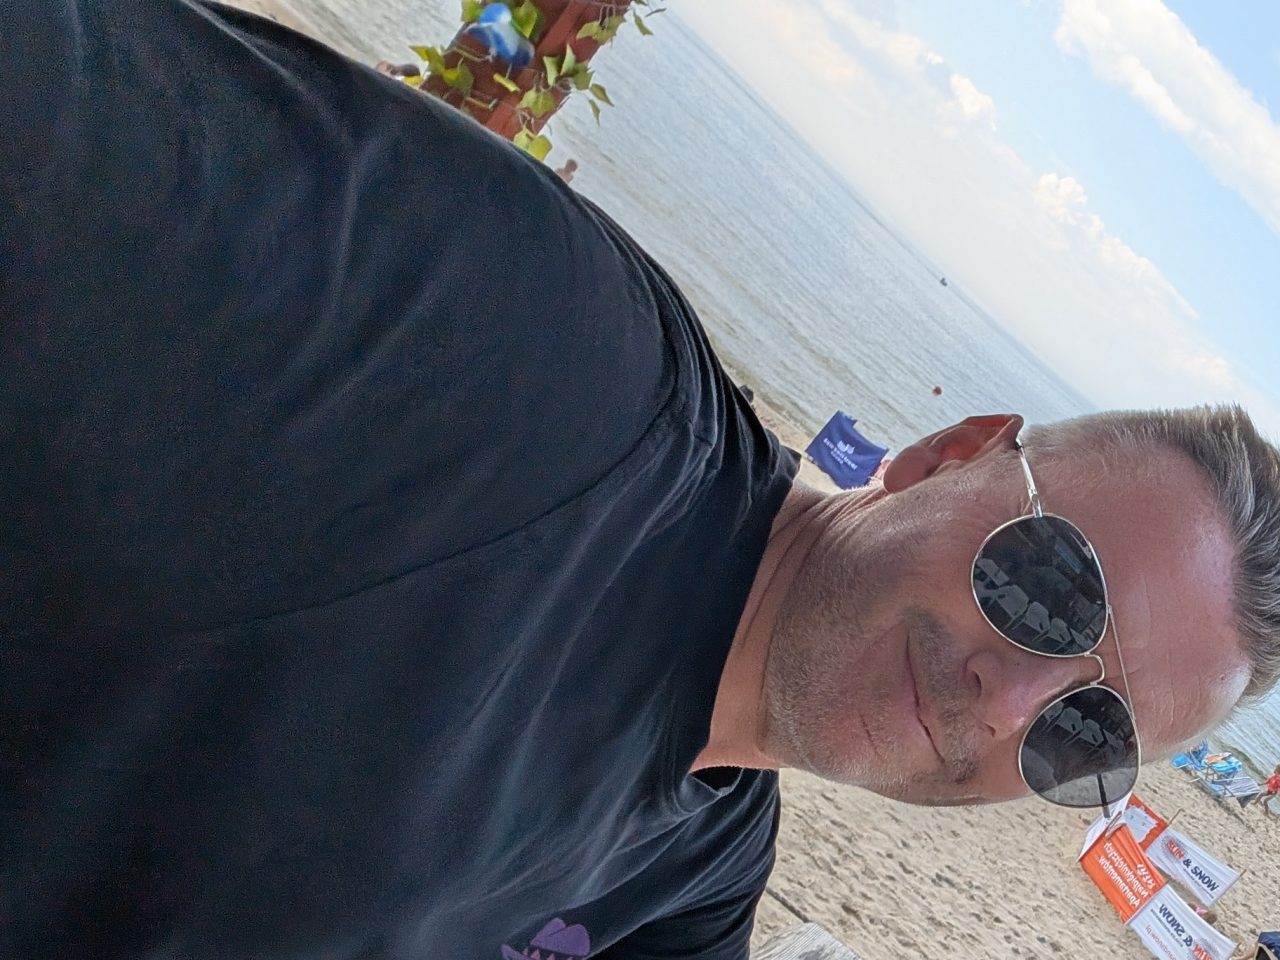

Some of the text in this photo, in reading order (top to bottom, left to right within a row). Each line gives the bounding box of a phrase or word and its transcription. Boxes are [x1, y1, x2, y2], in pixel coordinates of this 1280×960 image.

[1165, 838, 1185, 859] SUN
[1182, 858, 1192, 869] &
[1190, 865, 1220, 892] SNOW
